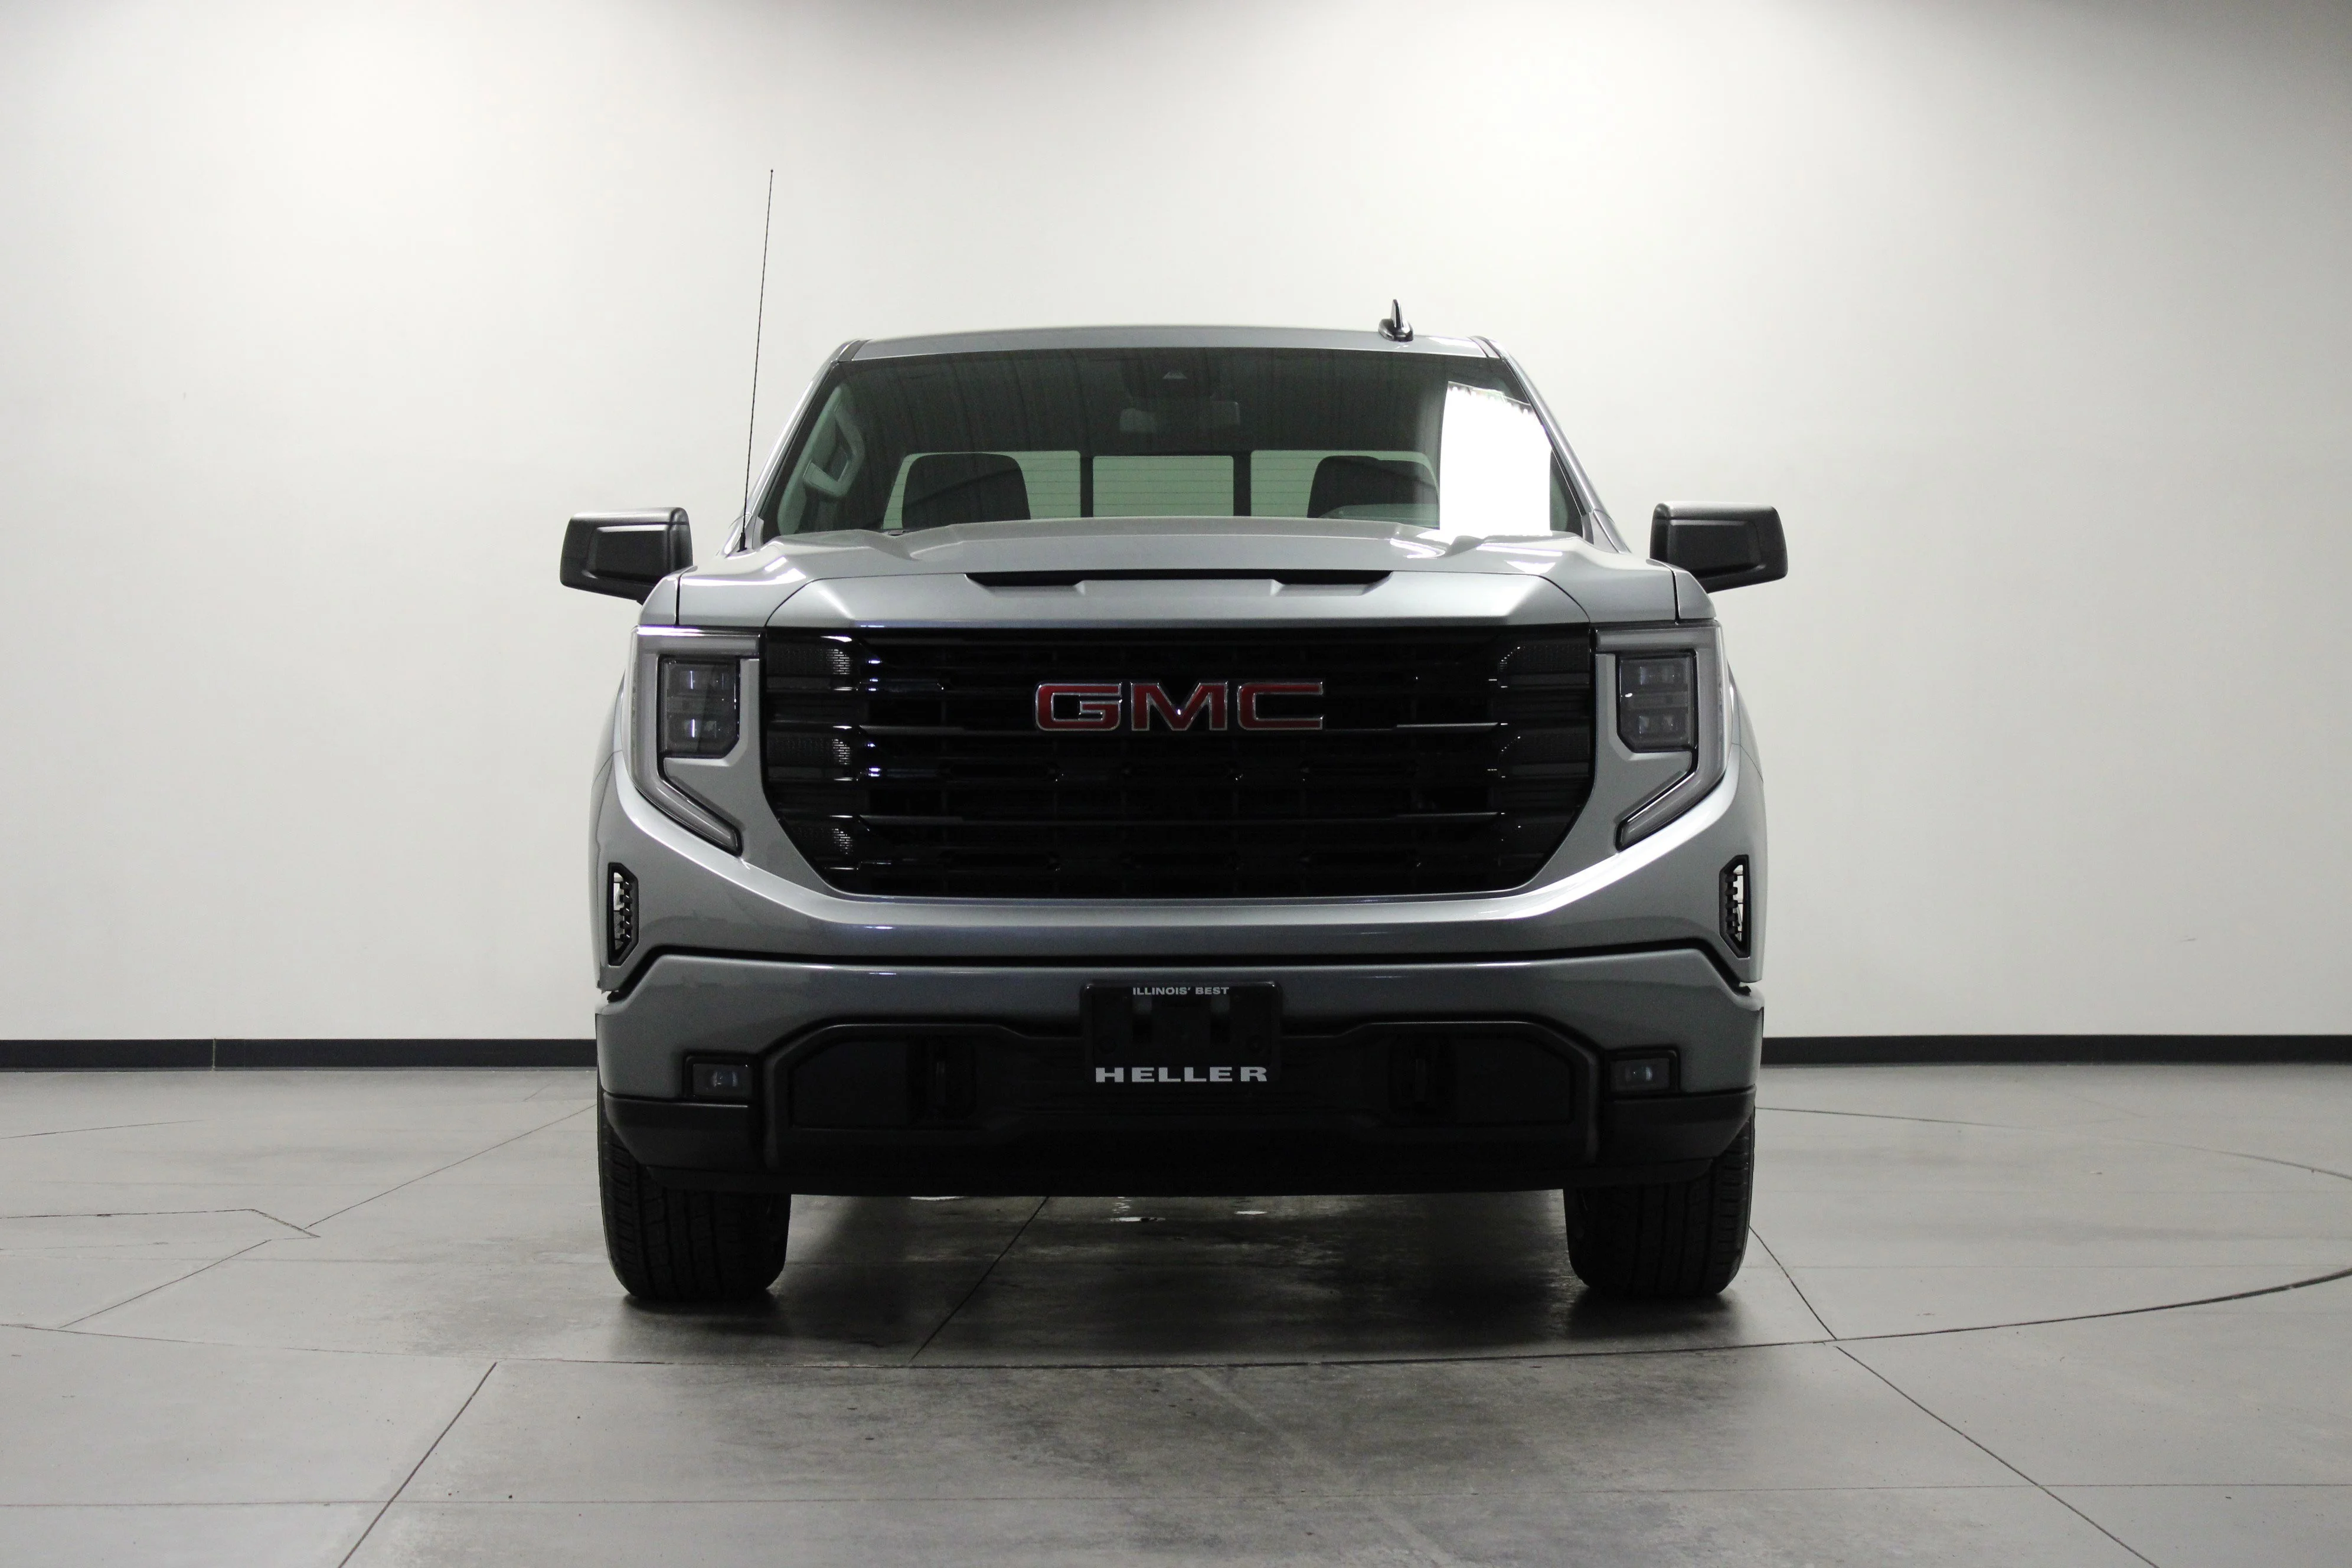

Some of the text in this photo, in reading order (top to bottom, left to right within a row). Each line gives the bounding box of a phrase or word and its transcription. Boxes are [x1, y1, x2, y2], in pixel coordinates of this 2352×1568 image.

[1035, 682, 1324, 731] GMC
[1132, 986, 1230, 995] ILLINOIS' BEST
[1096, 1066, 1268, 1083] HELLER
